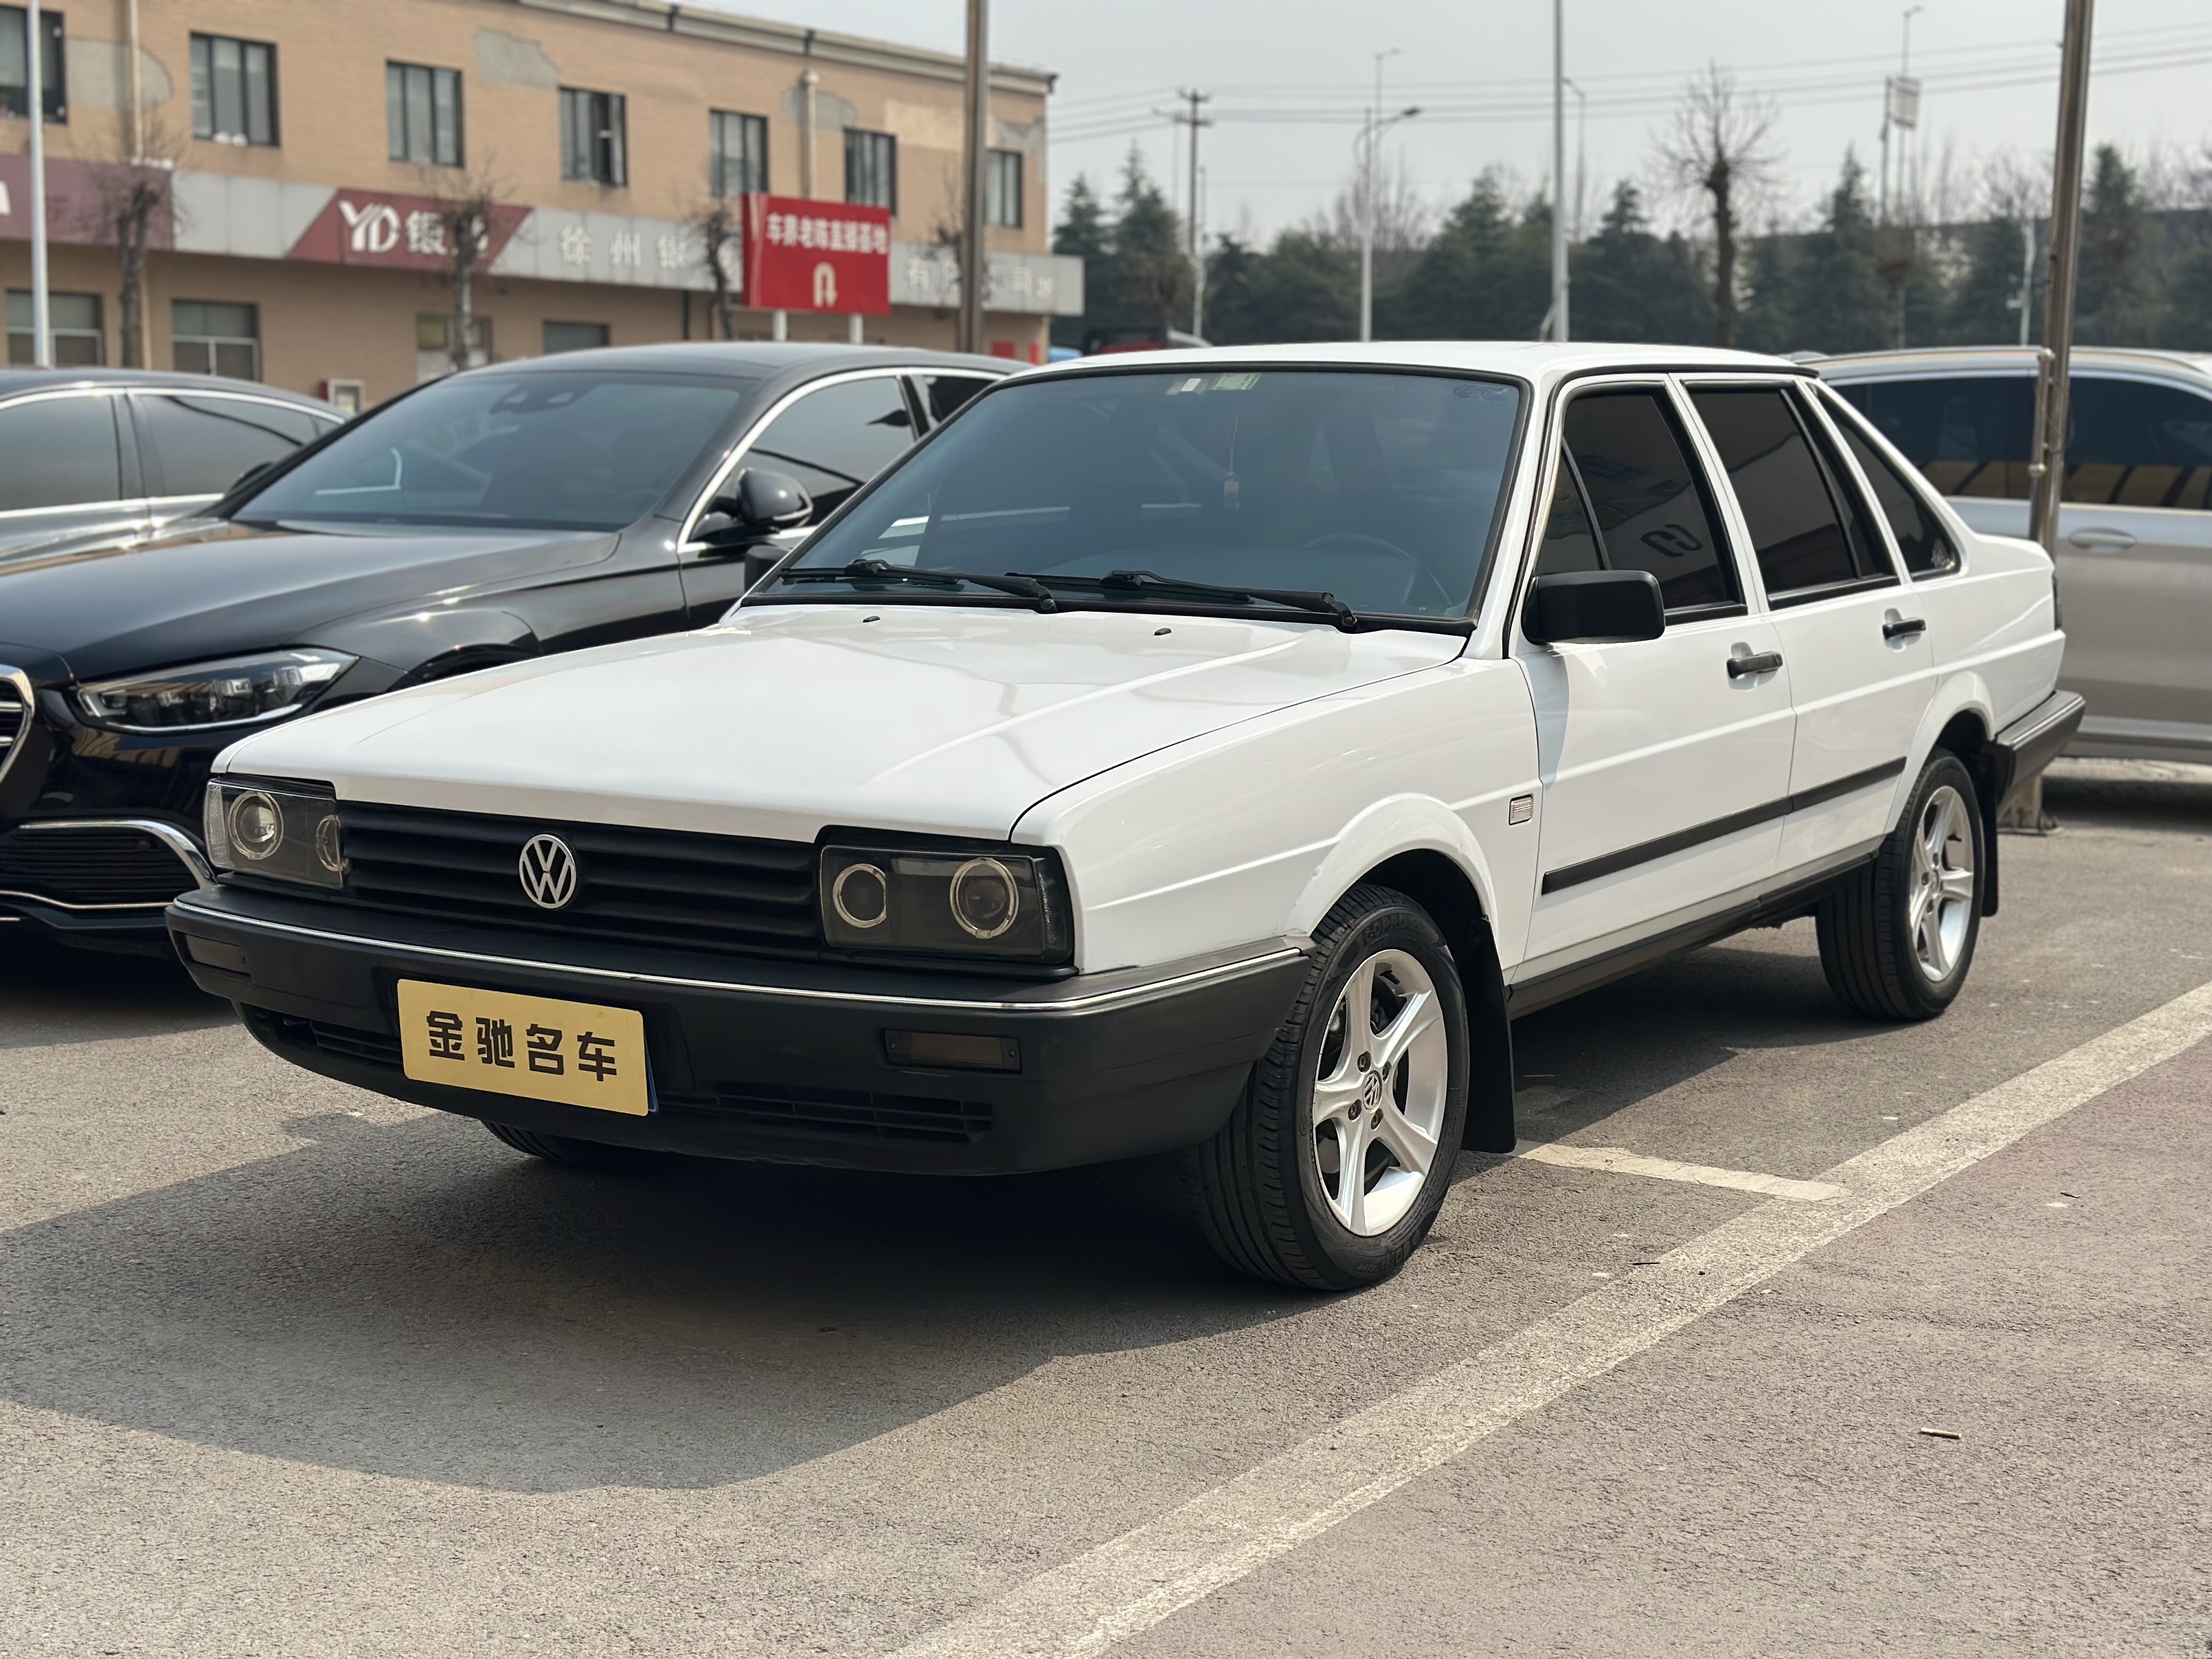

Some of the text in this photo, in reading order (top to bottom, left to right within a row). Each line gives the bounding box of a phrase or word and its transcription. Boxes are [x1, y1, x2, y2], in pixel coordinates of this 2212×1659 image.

[338, 200, 400, 252] YD
[426, 1010, 617, 1082] 金驰名车
